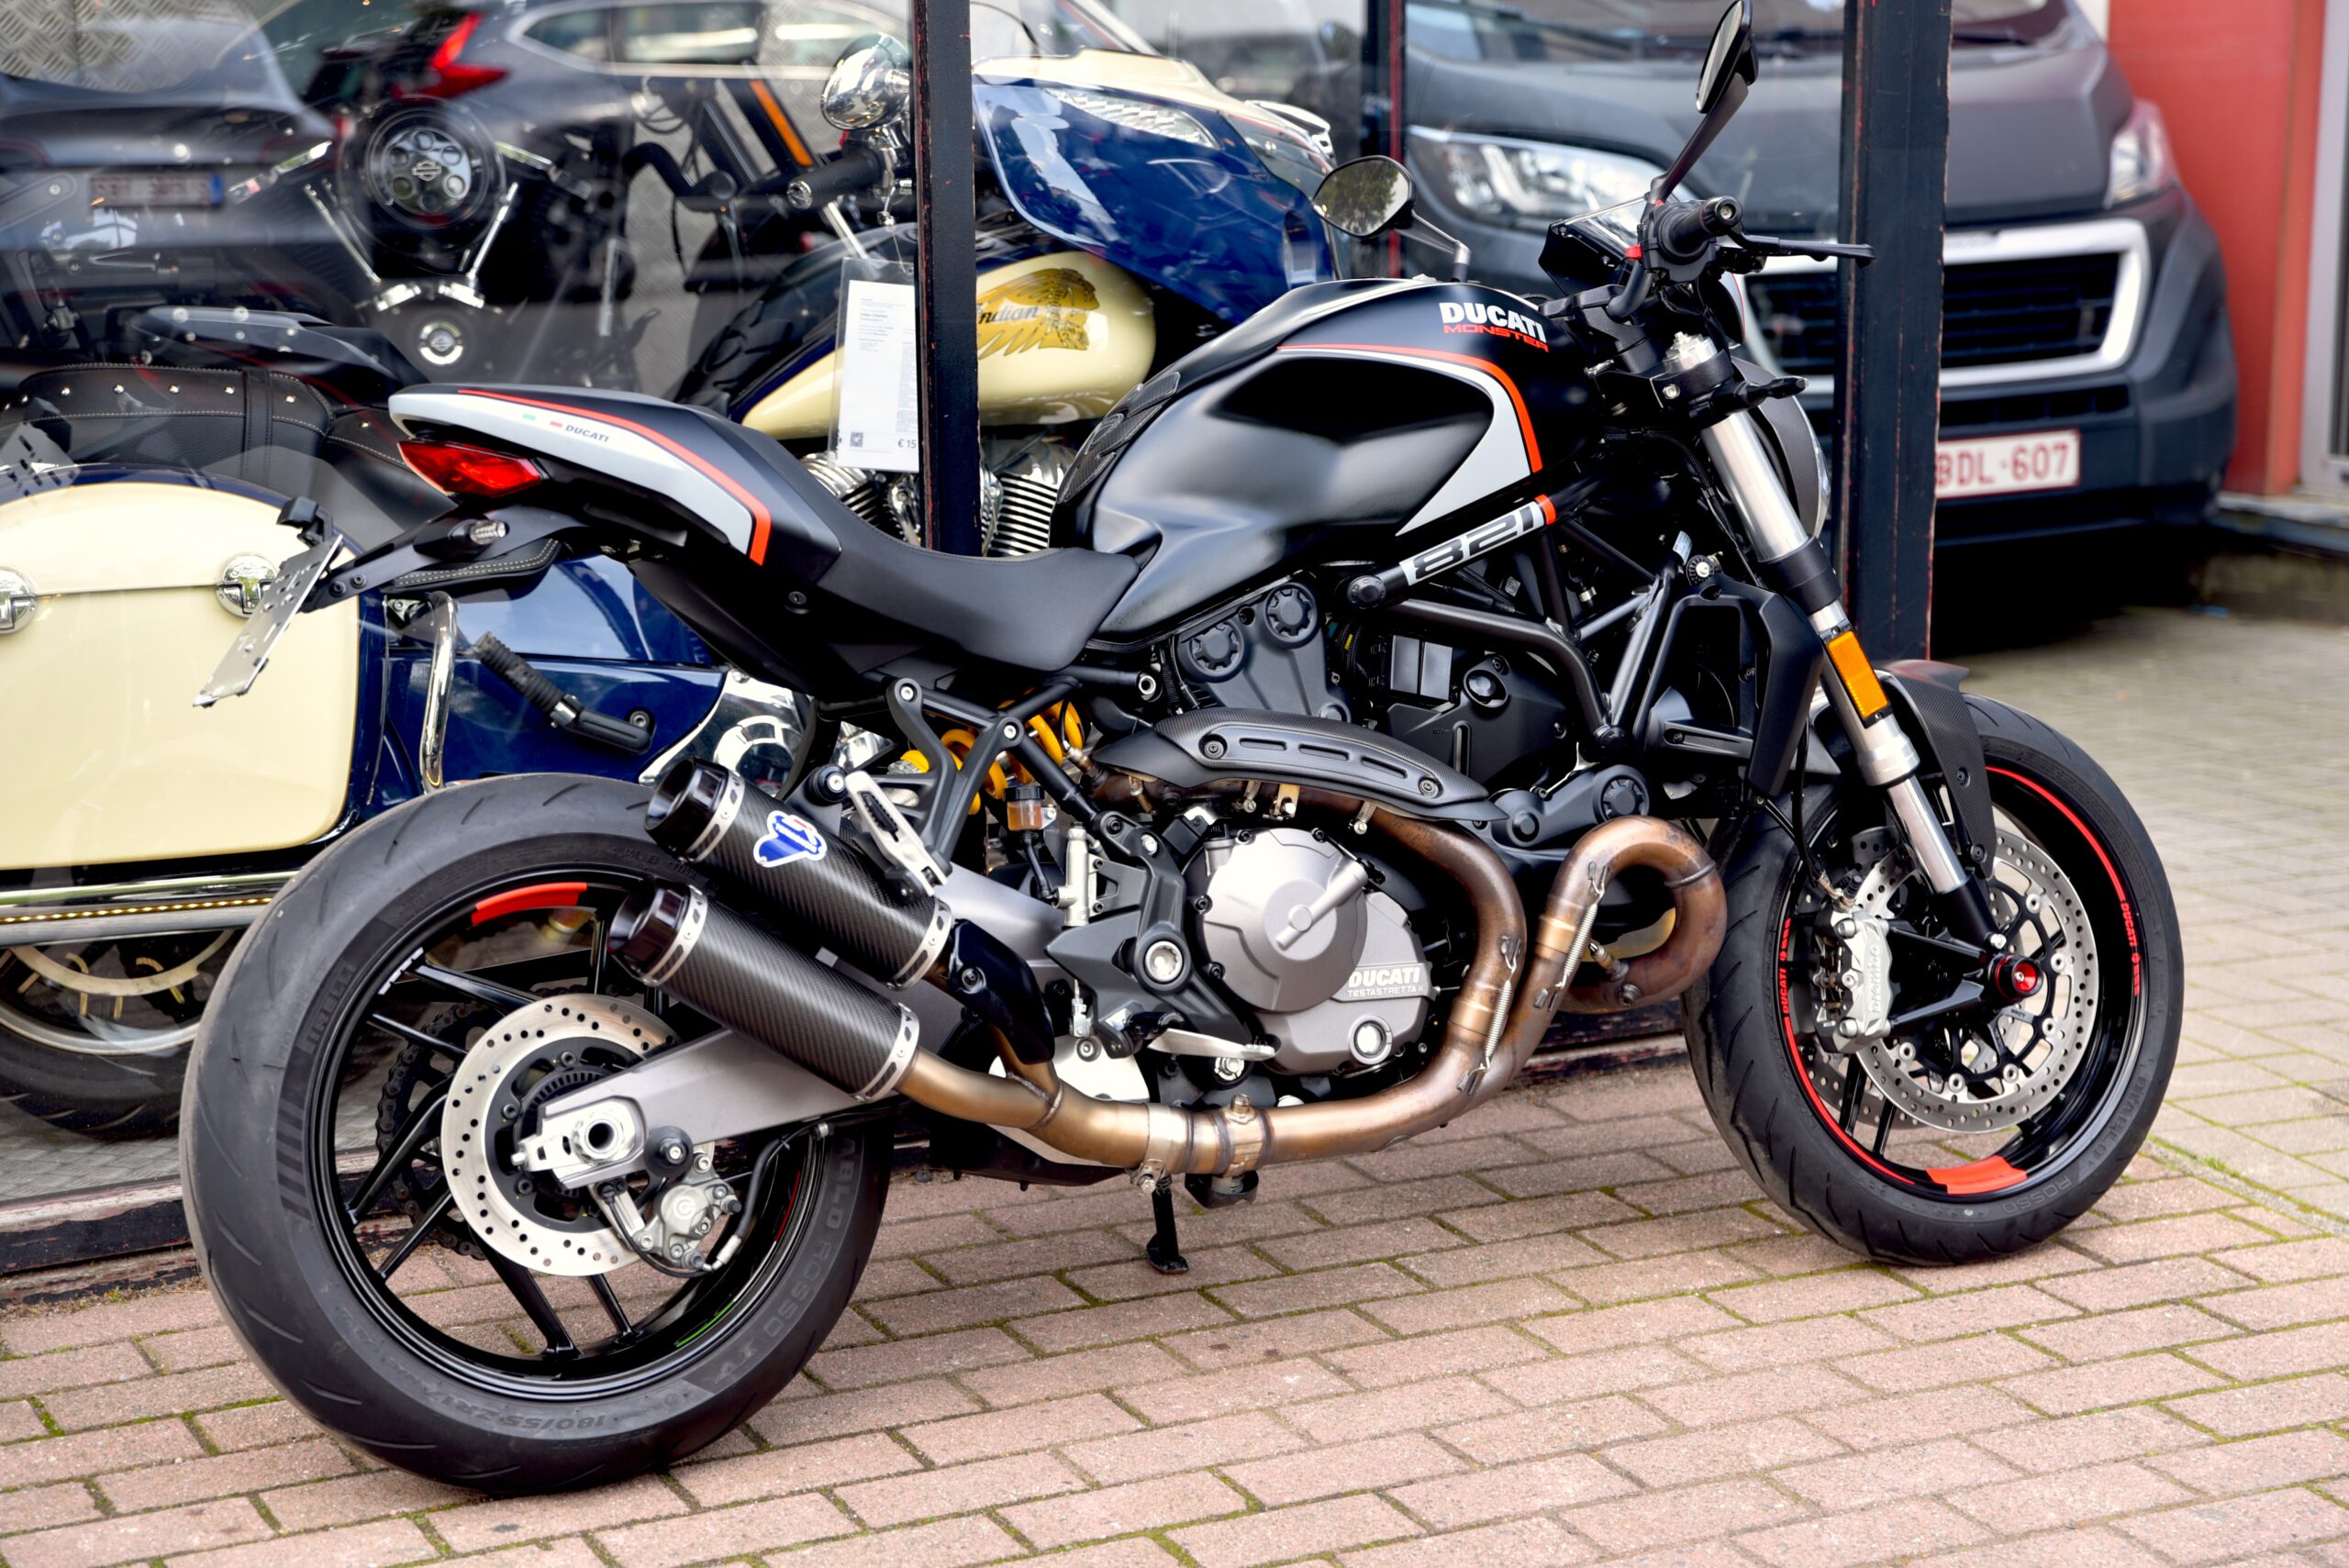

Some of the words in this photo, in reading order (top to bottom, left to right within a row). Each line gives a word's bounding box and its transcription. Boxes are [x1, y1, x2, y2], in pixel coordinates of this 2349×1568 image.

[1438, 302, 1548, 344] DUCATI
[1442, 323, 1550, 353] MONSTER
[565, 424, 609, 442] DUCATI
[1412, 506, 1534, 580] 821
[2120, 902, 2138, 947] DUCATI
[1348, 966, 1420, 988] DUCATI
[1348, 986, 1416, 998] TESTASTRETTA
[1778, 967, 1790, 1014] DUCATI
[1867, 943, 1881, 1014] brembo
[2092, 1076, 2147, 1160] DIABLO
[2002, 1173, 2073, 1215] ROSSO
[762, 1240, 830, 1339] ROSSO
[501, 1414, 607, 1429] 180/55
